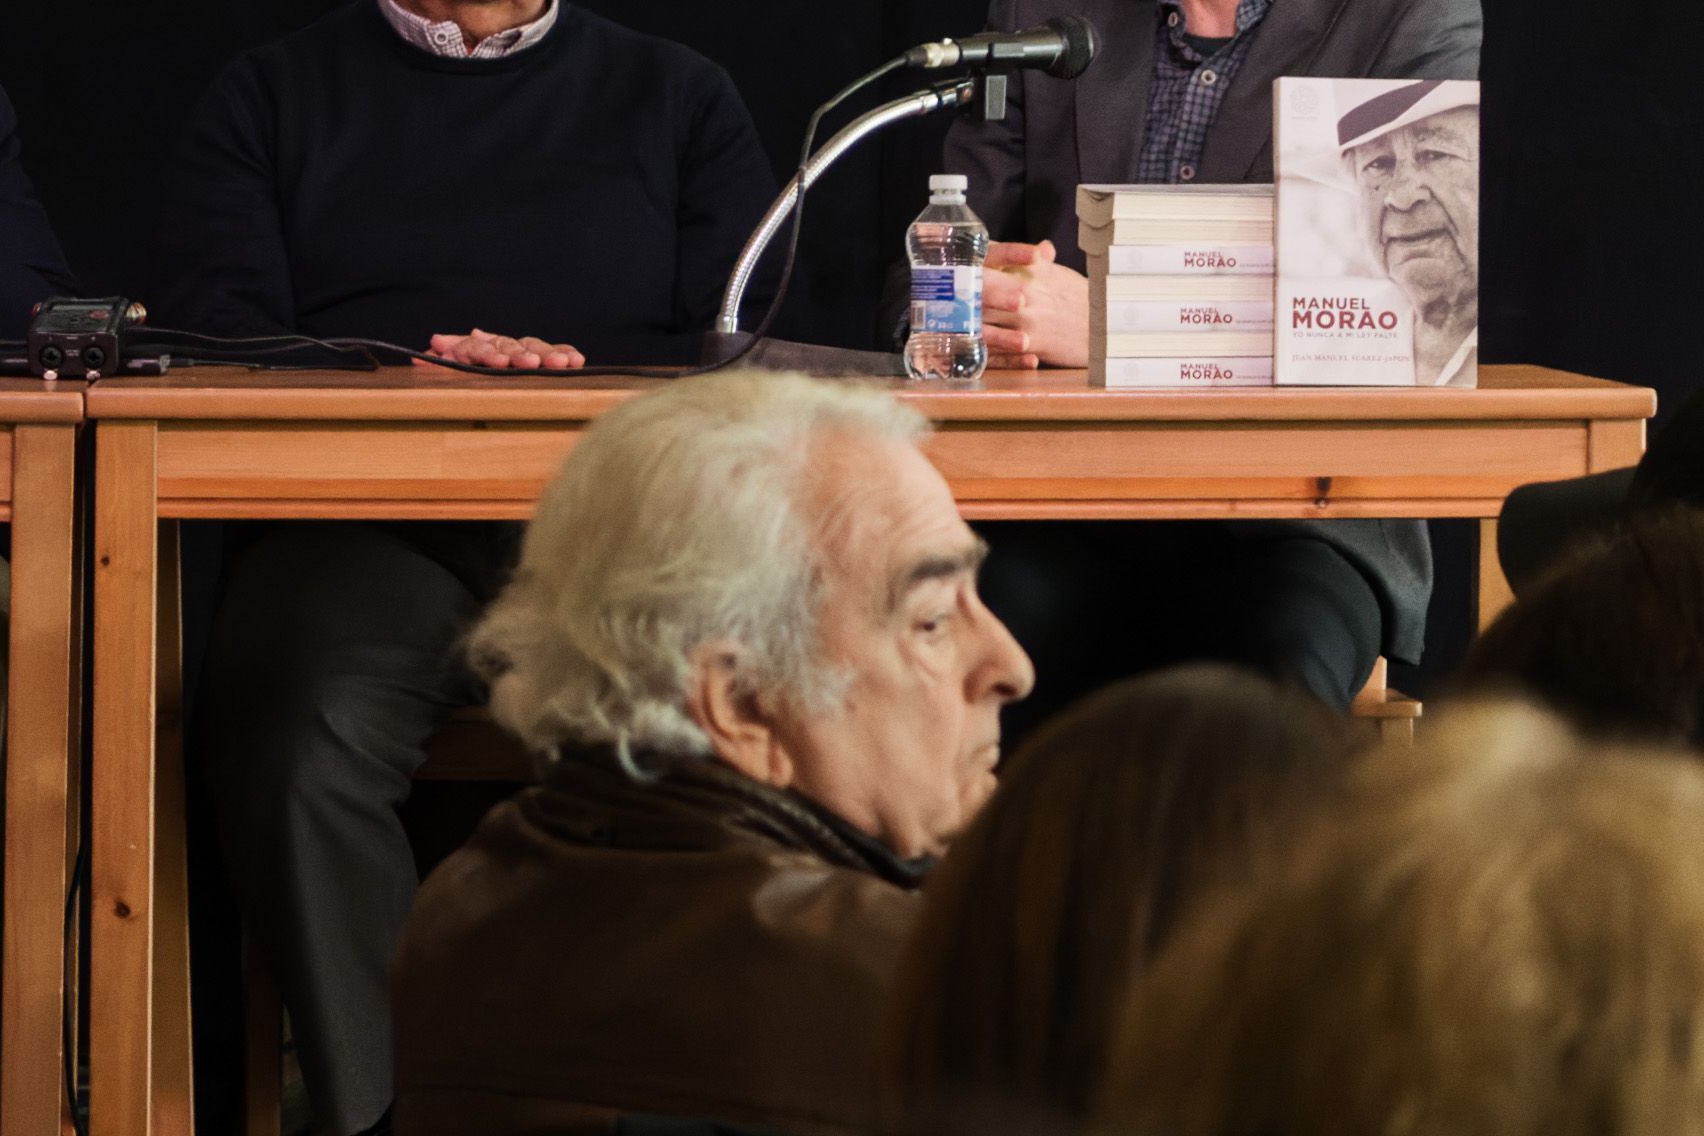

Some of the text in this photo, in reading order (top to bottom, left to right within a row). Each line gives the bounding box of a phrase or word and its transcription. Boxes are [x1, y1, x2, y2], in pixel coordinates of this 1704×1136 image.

[1184, 257, 1237, 268] MORAO
[1292, 297, 1371, 310] MANUEL
[1181, 313, 1233, 324] MORAO
[1292, 310, 1398, 330] MORAO
[1181, 369, 1233, 380] MORAO
